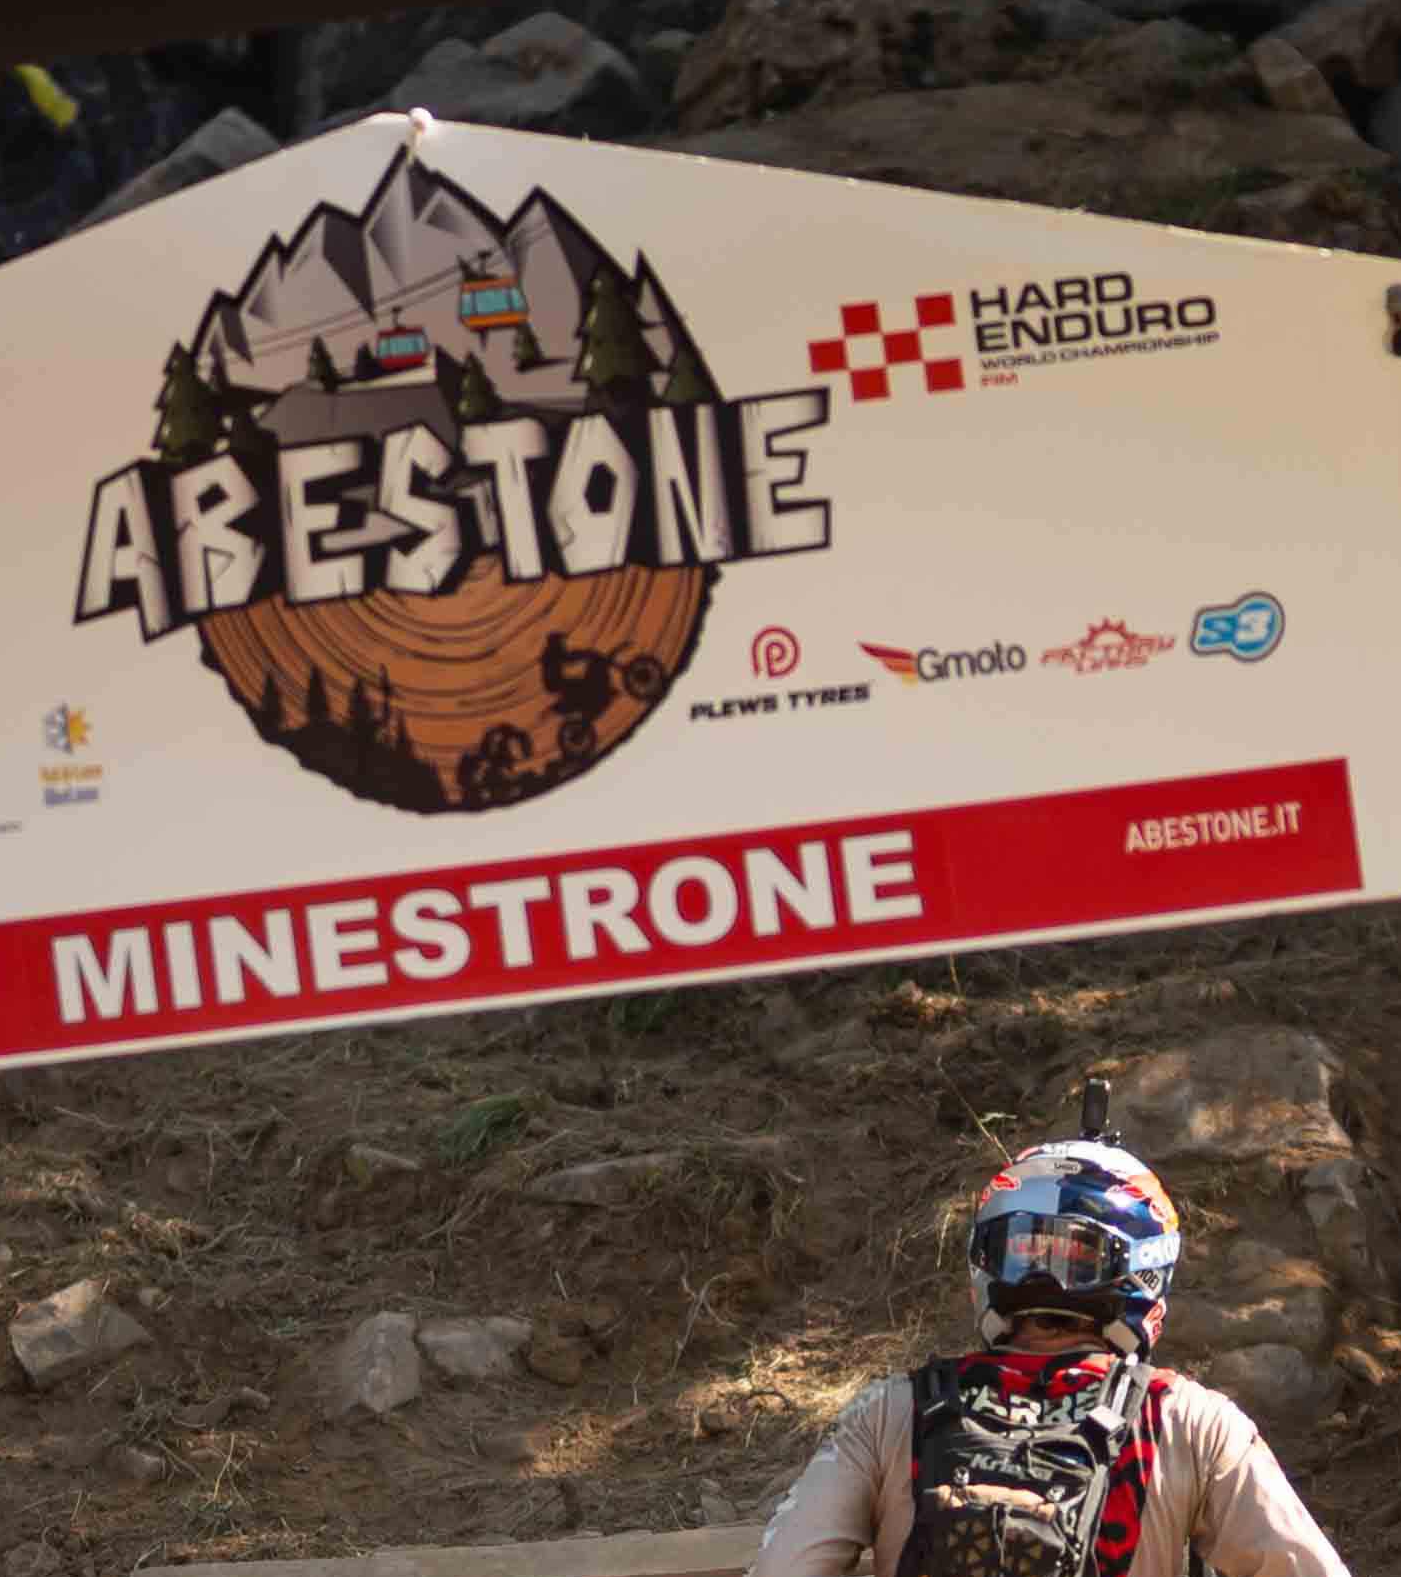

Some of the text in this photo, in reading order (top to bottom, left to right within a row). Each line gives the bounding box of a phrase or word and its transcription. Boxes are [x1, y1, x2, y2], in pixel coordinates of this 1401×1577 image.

[970, 272, 1133, 319] HARD
[975, 296, 1217, 354] ENDURO
[981, 332, 1220, 371] WORLD CHAMPIONSHIP
[73, 387, 831, 644] ABESTONE
[915, 640, 1027, 684] Gmoto
[689, 683, 871, 722] PLEWS TYRES
[1125, 803, 1302, 855] ABESTONE.IT
[52, 830, 923, 1024] MINESTRONE
[970, 1452, 1052, 1481] Krie
